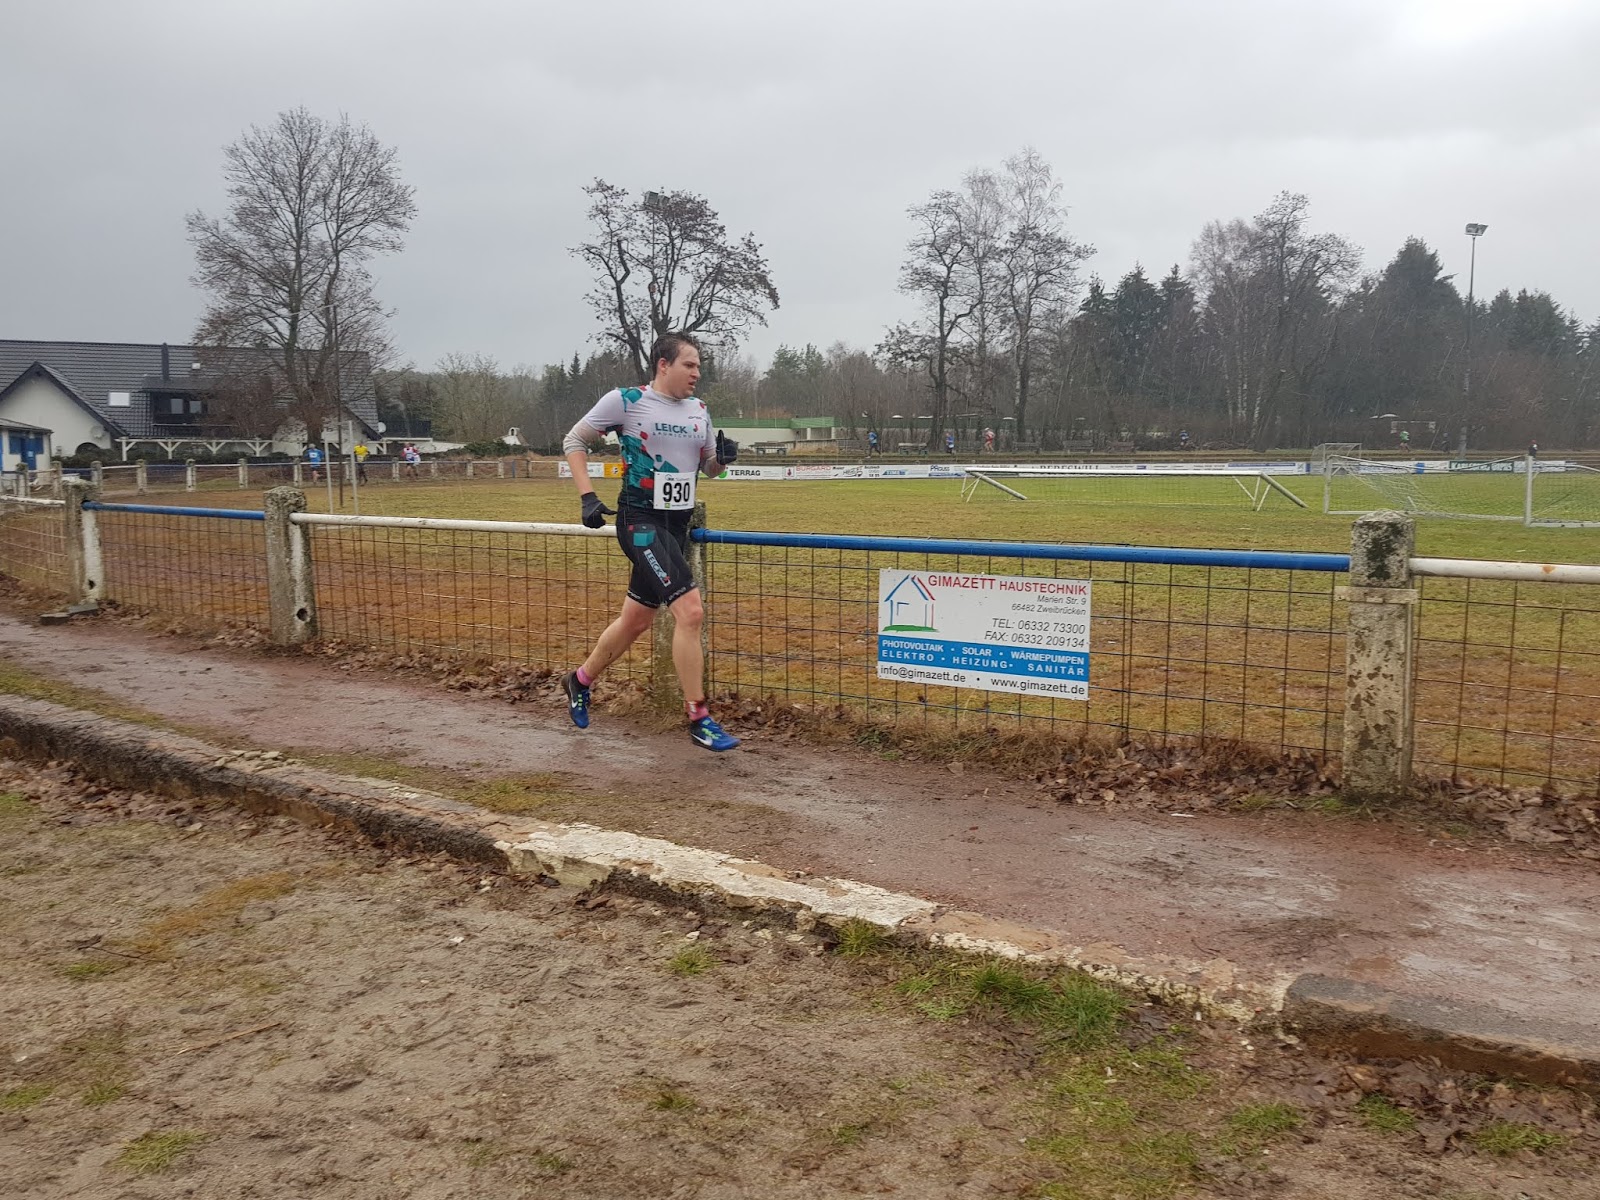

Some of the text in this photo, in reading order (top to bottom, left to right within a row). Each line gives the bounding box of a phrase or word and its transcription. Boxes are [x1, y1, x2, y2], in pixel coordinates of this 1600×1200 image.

[655, 423, 687, 434] LEICK
[662, 482, 690, 503] 930
[646, 552, 663, 576] LEICK
[928, 575, 1087, 595] GIMAZETT HAUSTECHNIK
[1012, 603, 1086, 616] 66482 Zweibrücken
[1037, 595, 1087, 606] Marien Str. 9
[992, 618, 1086, 634] TEL: 06332 73300
[984, 631, 1085, 648] FAX: 06332 209134
[882, 640, 1085, 665] PHOTOVOLTAIK SOLAR WÄRMEPUMPEN
[881, 650, 935, 662] ELEKTRO
[1027, 662, 1085, 676] SANITÄR
[880, 665, 1085, 695] info@gimazett.de www.gimazett.de
